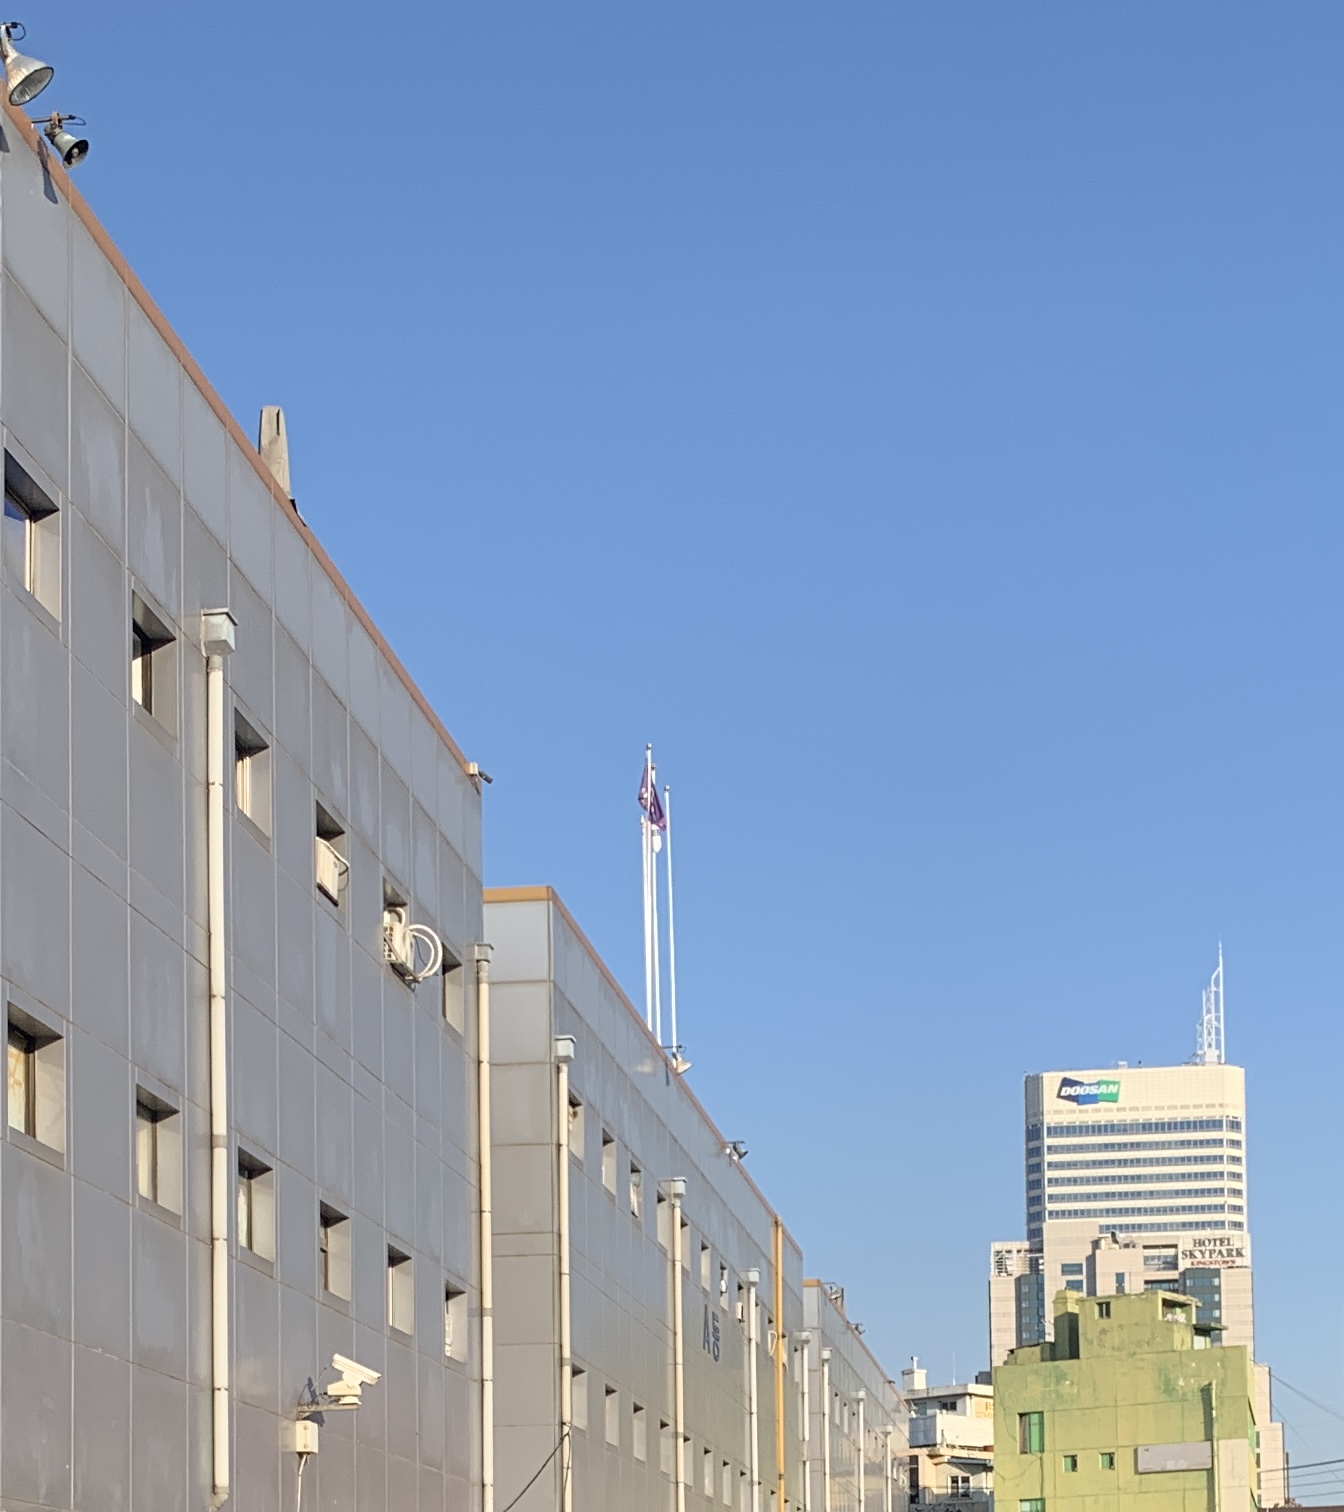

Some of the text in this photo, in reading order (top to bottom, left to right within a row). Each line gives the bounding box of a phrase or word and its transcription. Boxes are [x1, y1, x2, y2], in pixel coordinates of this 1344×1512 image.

[1060, 1084, 1119, 1097] DOOSAN
[1193, 1237, 1234, 1248] HOTEL
[1181, 1247, 1246, 1260] SKYPARK
